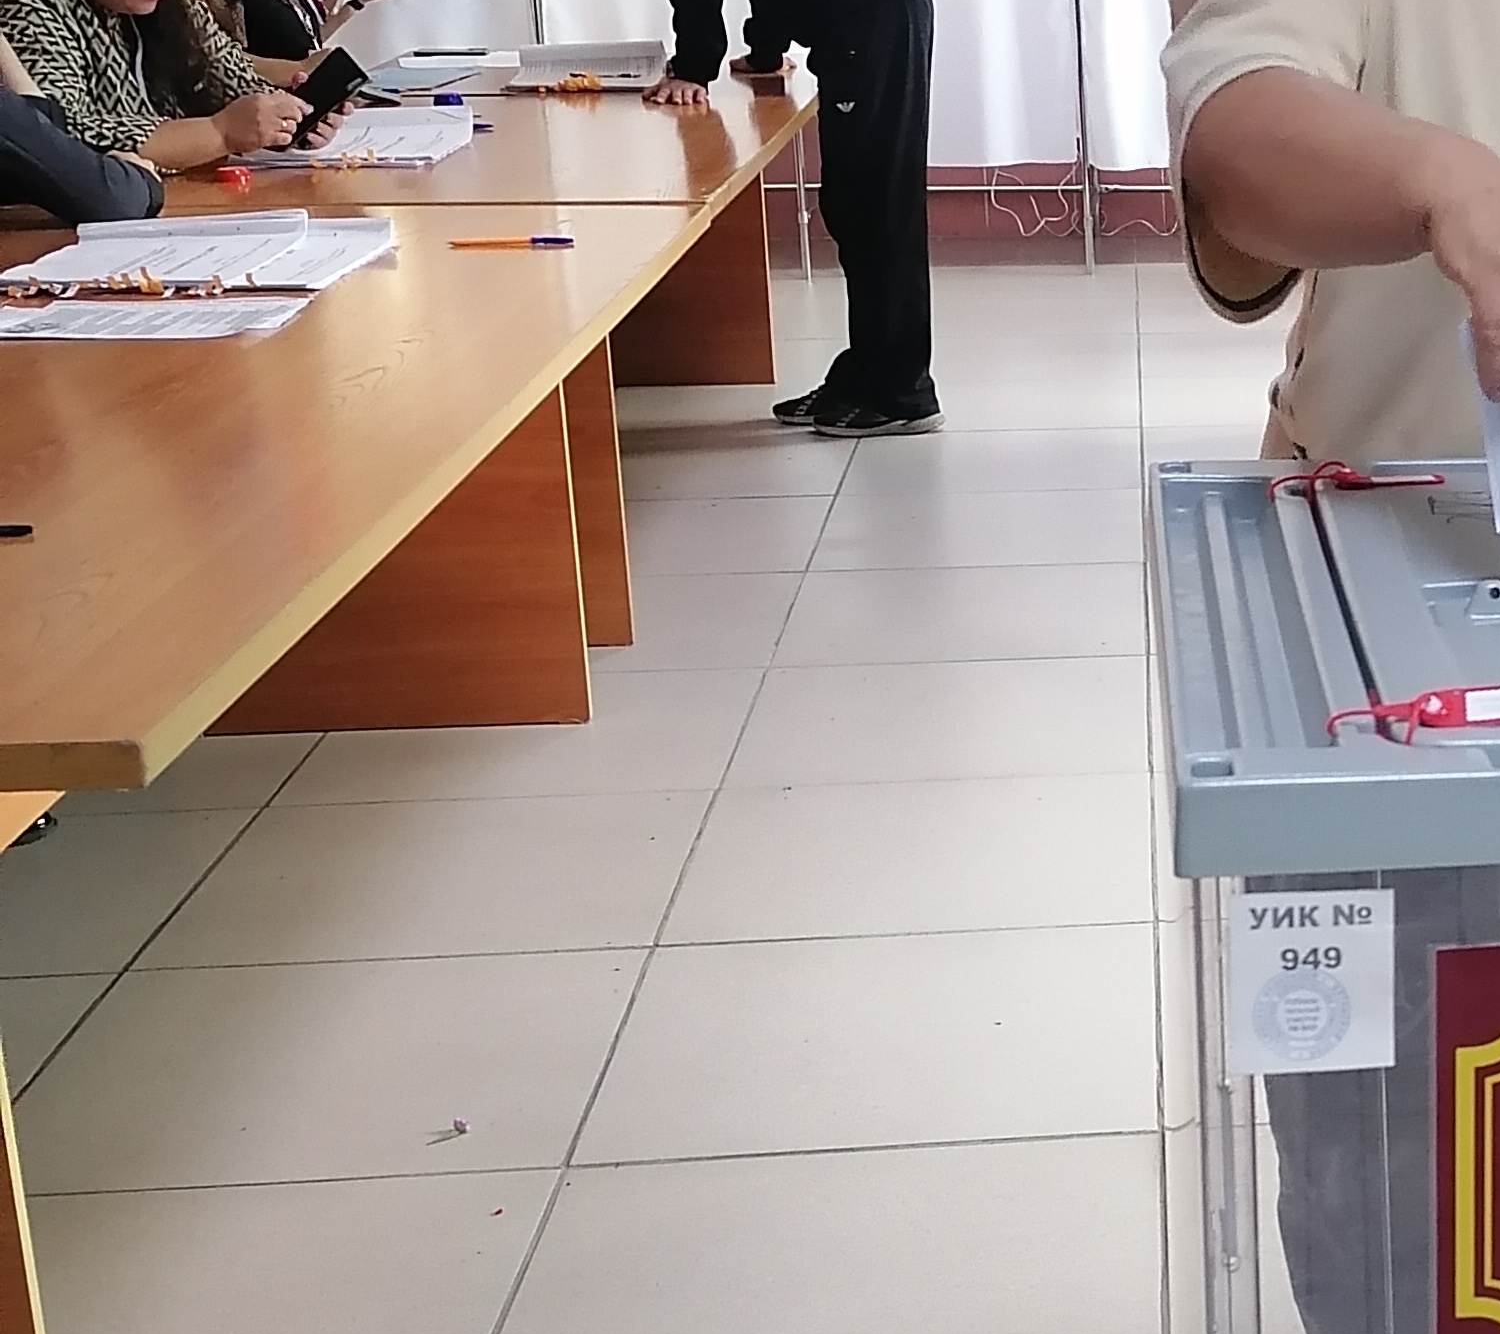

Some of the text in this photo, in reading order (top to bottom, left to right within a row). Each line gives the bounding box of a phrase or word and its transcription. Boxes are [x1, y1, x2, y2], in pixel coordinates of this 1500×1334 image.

[1249, 904, 1373, 930] УИК №
[1280, 946, 1342, 971] 949
